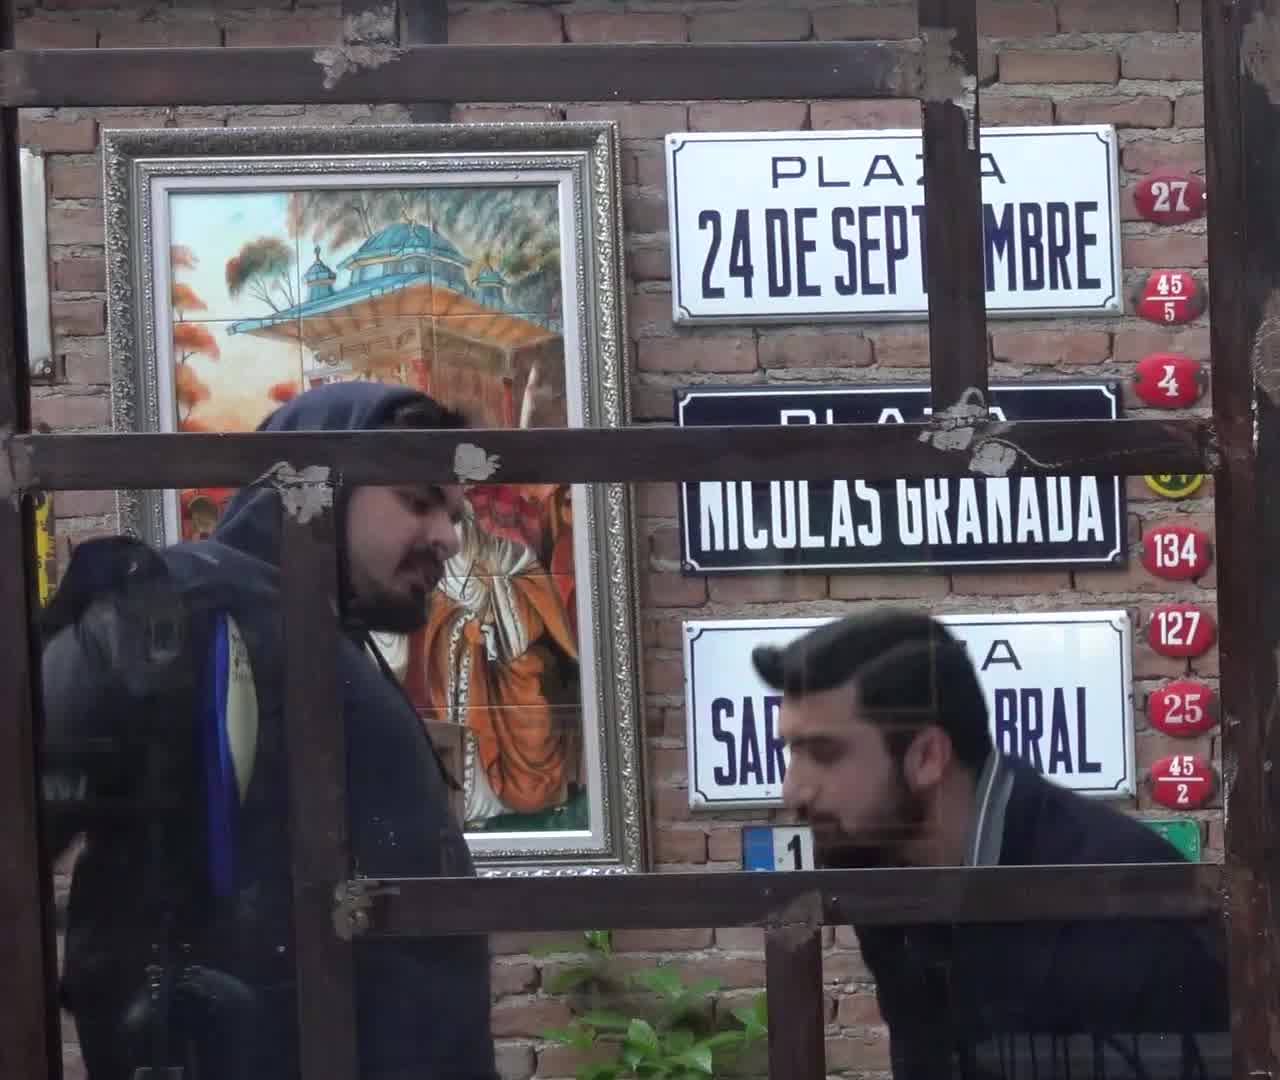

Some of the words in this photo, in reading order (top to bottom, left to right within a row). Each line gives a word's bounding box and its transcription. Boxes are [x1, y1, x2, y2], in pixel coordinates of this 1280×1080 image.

[1151, 181, 1191, 212] 27
[698, 208, 754, 299] 24
[765, 207, 821, 298] DE
[831, 201, 1101, 296] SEPTMBRE
[1156, 274, 1183, 295] 45
[1164, 302, 1176, 322] 5
[1157, 365, 1180, 397] 4
[699, 478, 882, 551] NICOLAS
[895, 475, 1105, 546] GRANADA
[1153, 533, 1197, 567] 134
[1158, 612, 1200, 645] 127
[1164, 694, 1203, 723] 25
[1169, 756, 1194, 776] 45
[1177, 784, 1189, 803] 2
